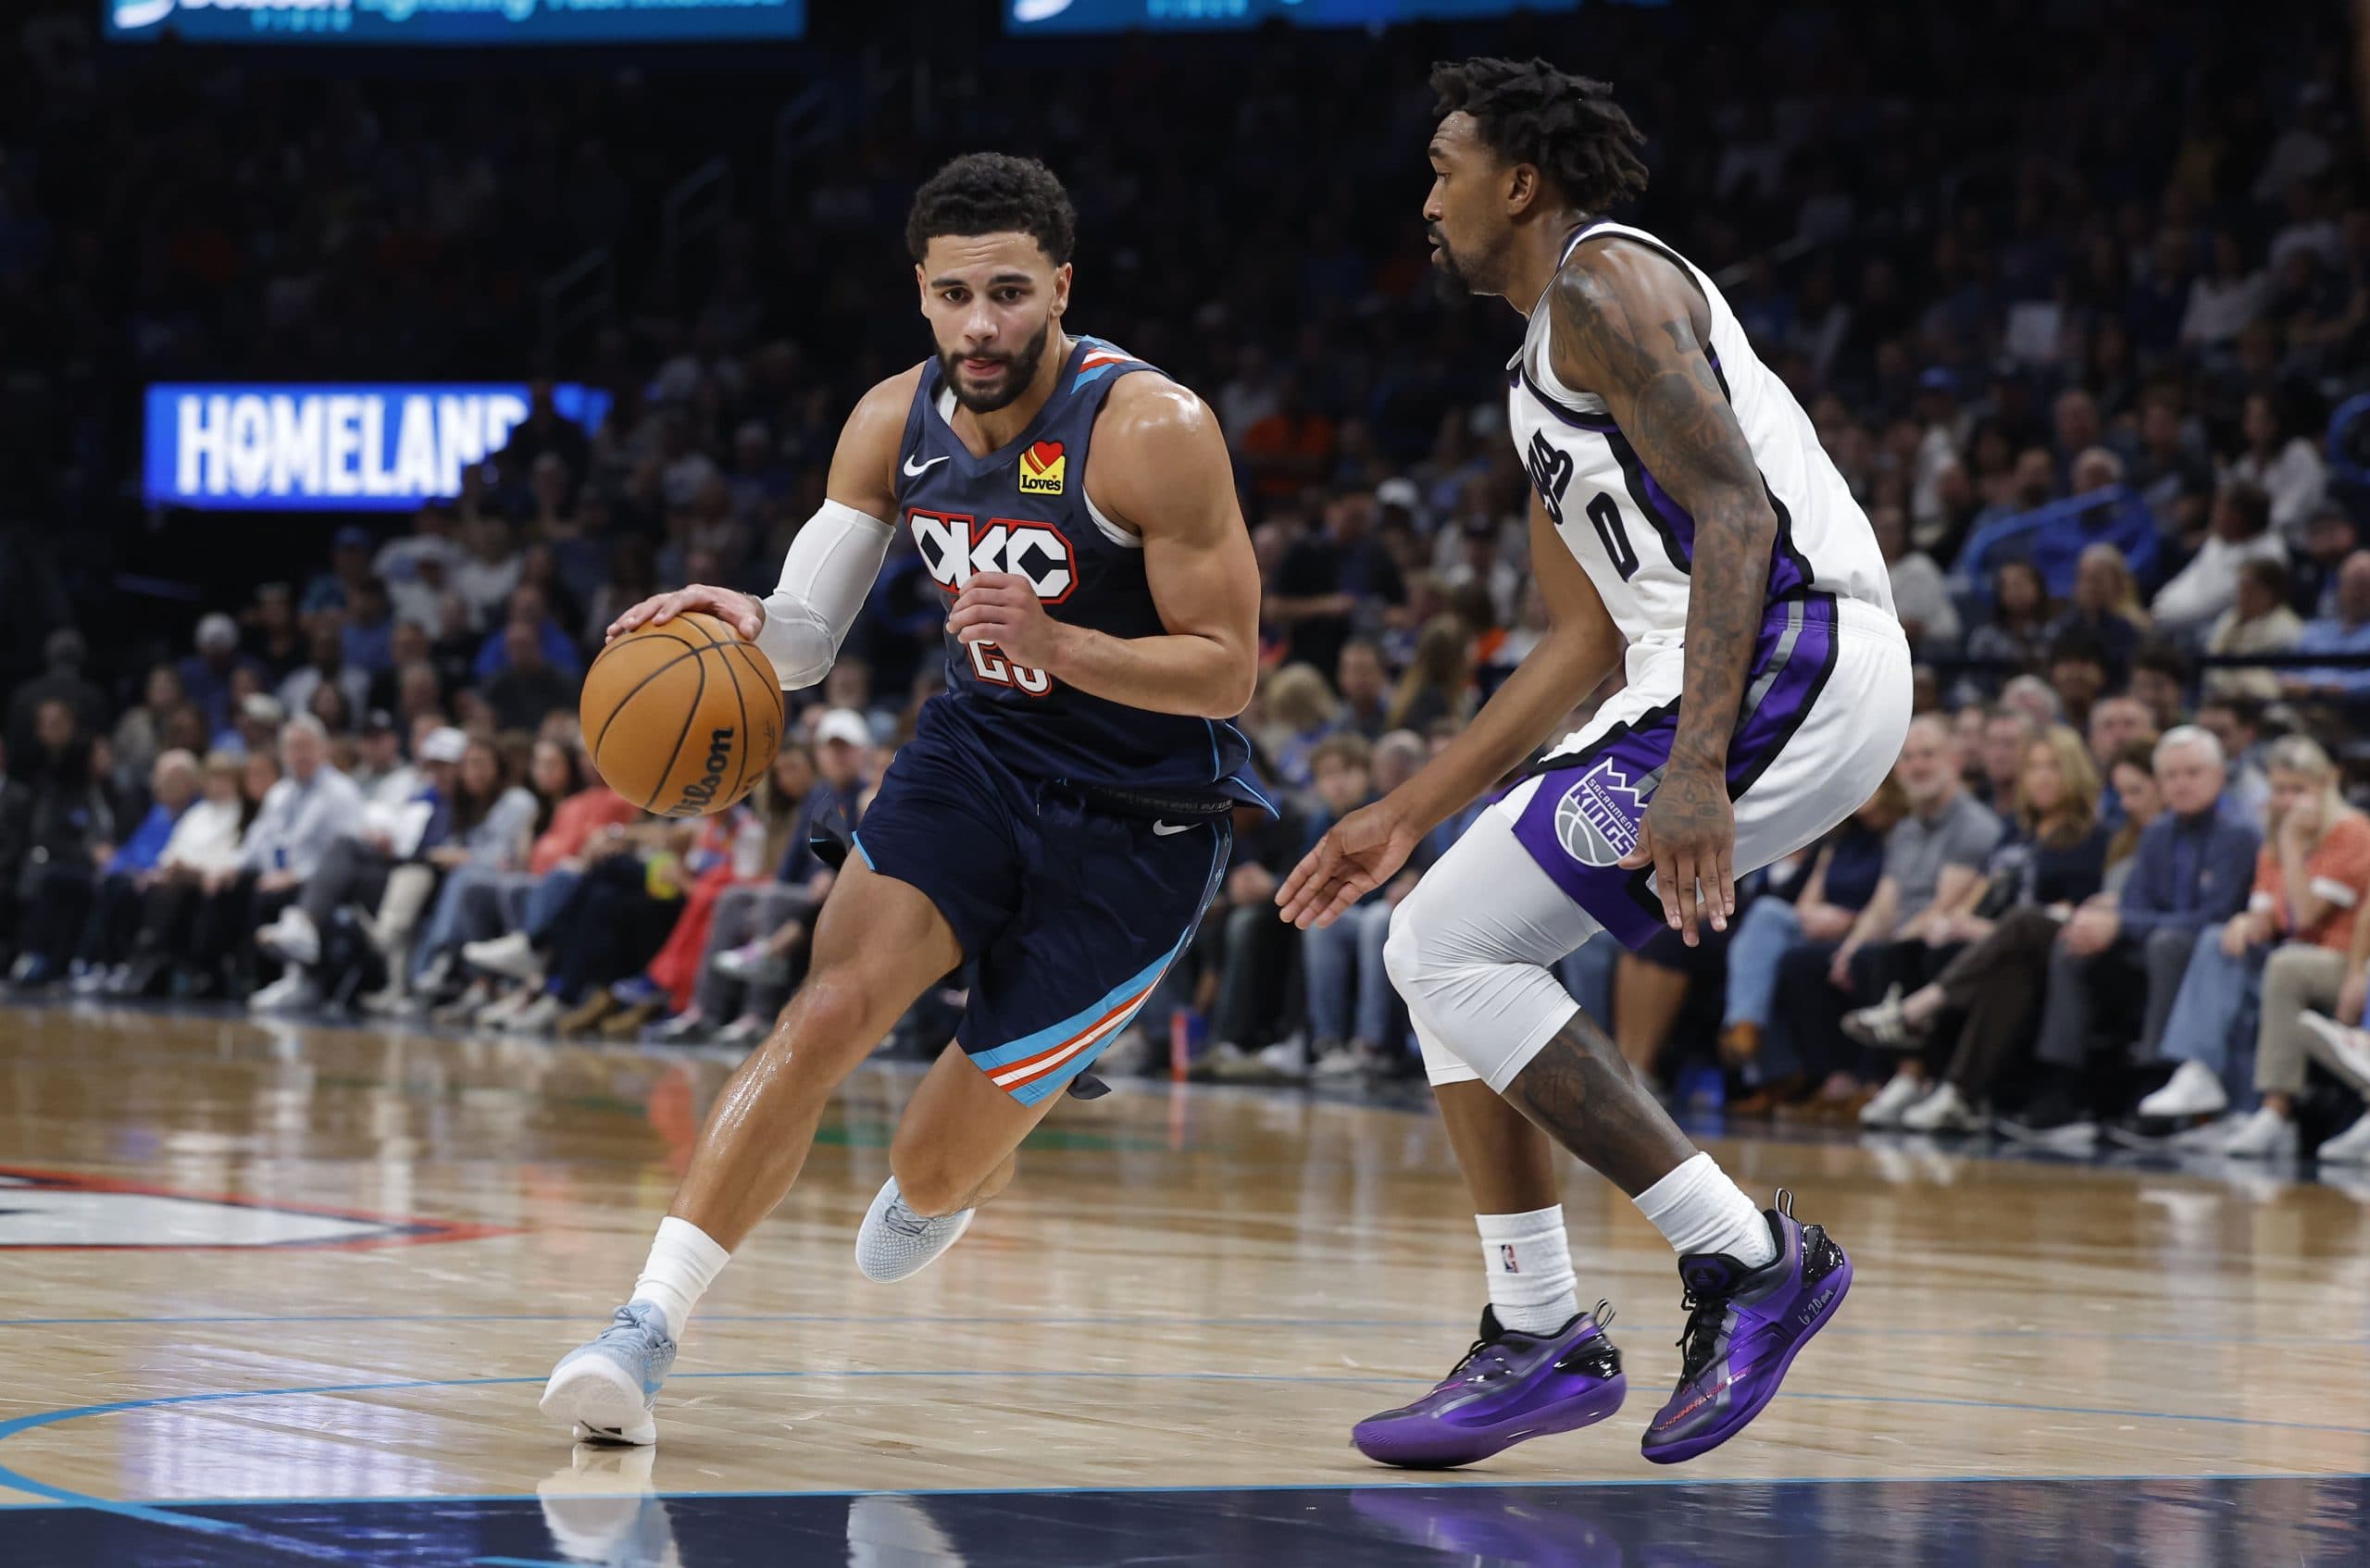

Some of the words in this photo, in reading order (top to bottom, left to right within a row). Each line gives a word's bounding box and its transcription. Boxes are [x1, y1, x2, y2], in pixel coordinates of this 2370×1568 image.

[908, 509, 1077, 604] OKC
[1586, 492, 1639, 583] 0
[1570, 784, 1635, 857] KINGS
